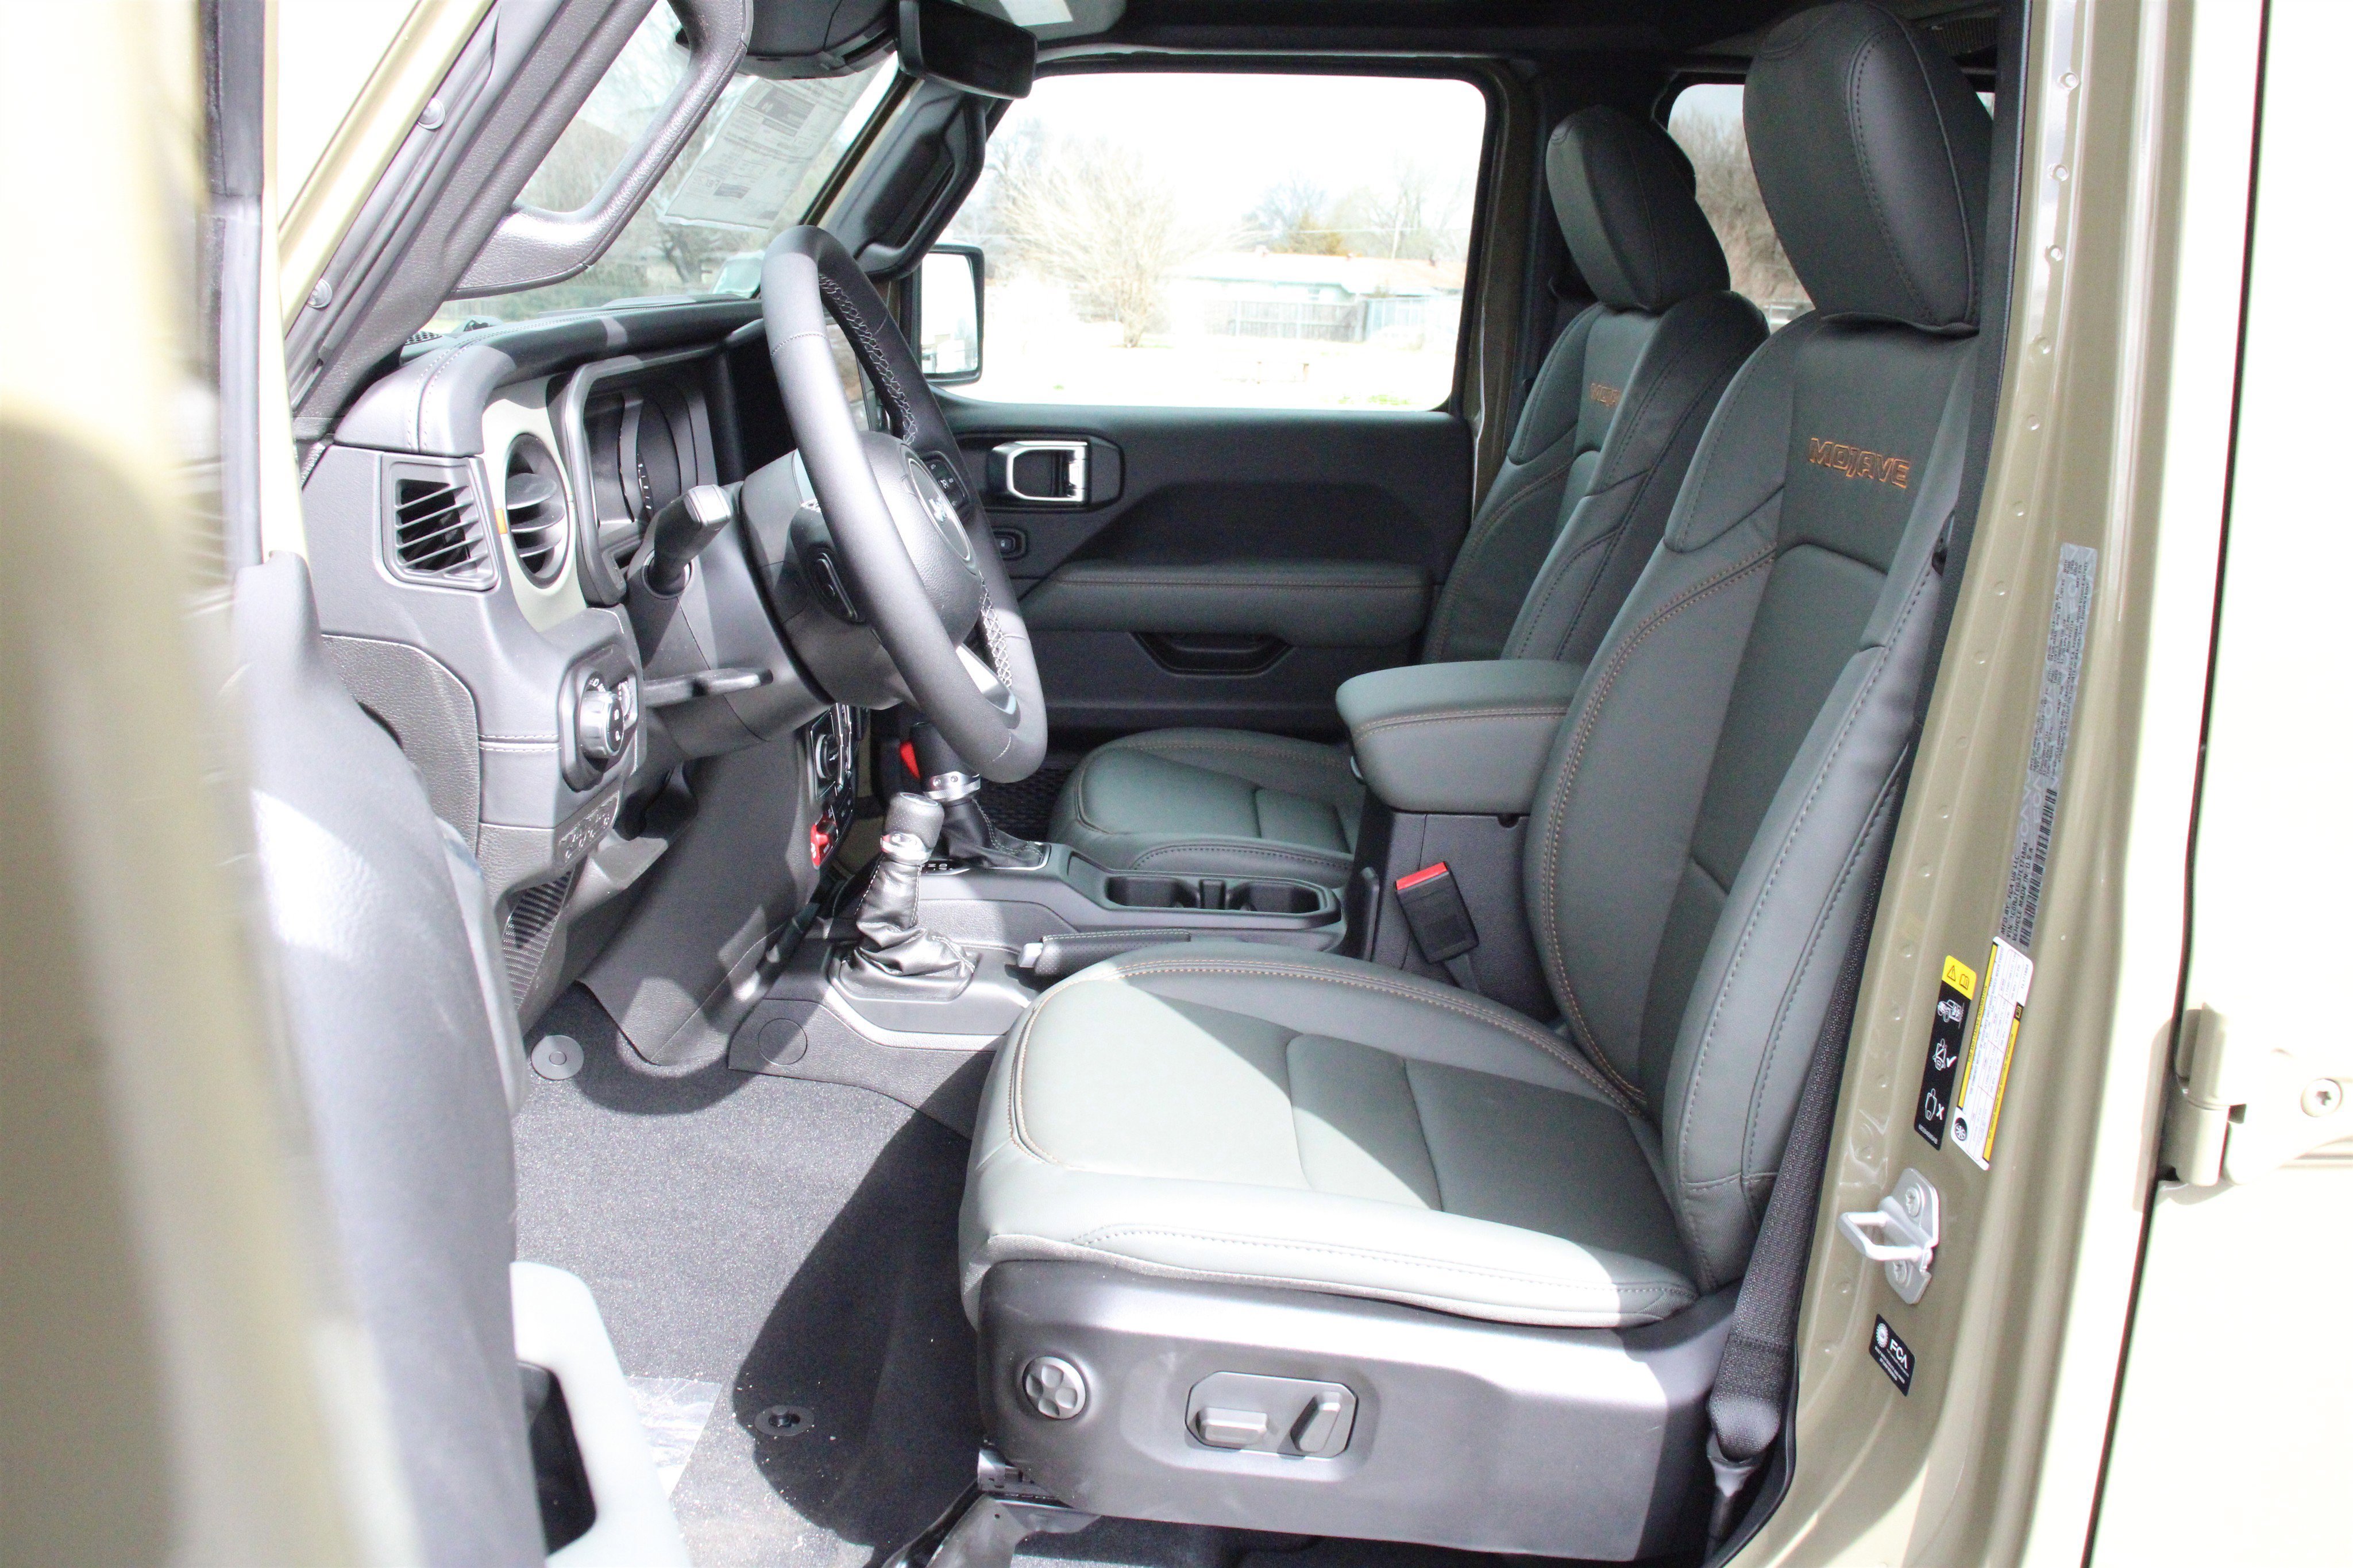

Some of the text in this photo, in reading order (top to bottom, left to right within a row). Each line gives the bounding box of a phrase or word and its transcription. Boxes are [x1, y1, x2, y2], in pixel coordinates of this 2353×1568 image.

[1810, 438, 1911, 488] MOJAVE
[2011, 870, 2016, 881] US
[2012, 910, 2022, 941] VEHICLE
[1889, 1339, 1908, 1369] FCA
